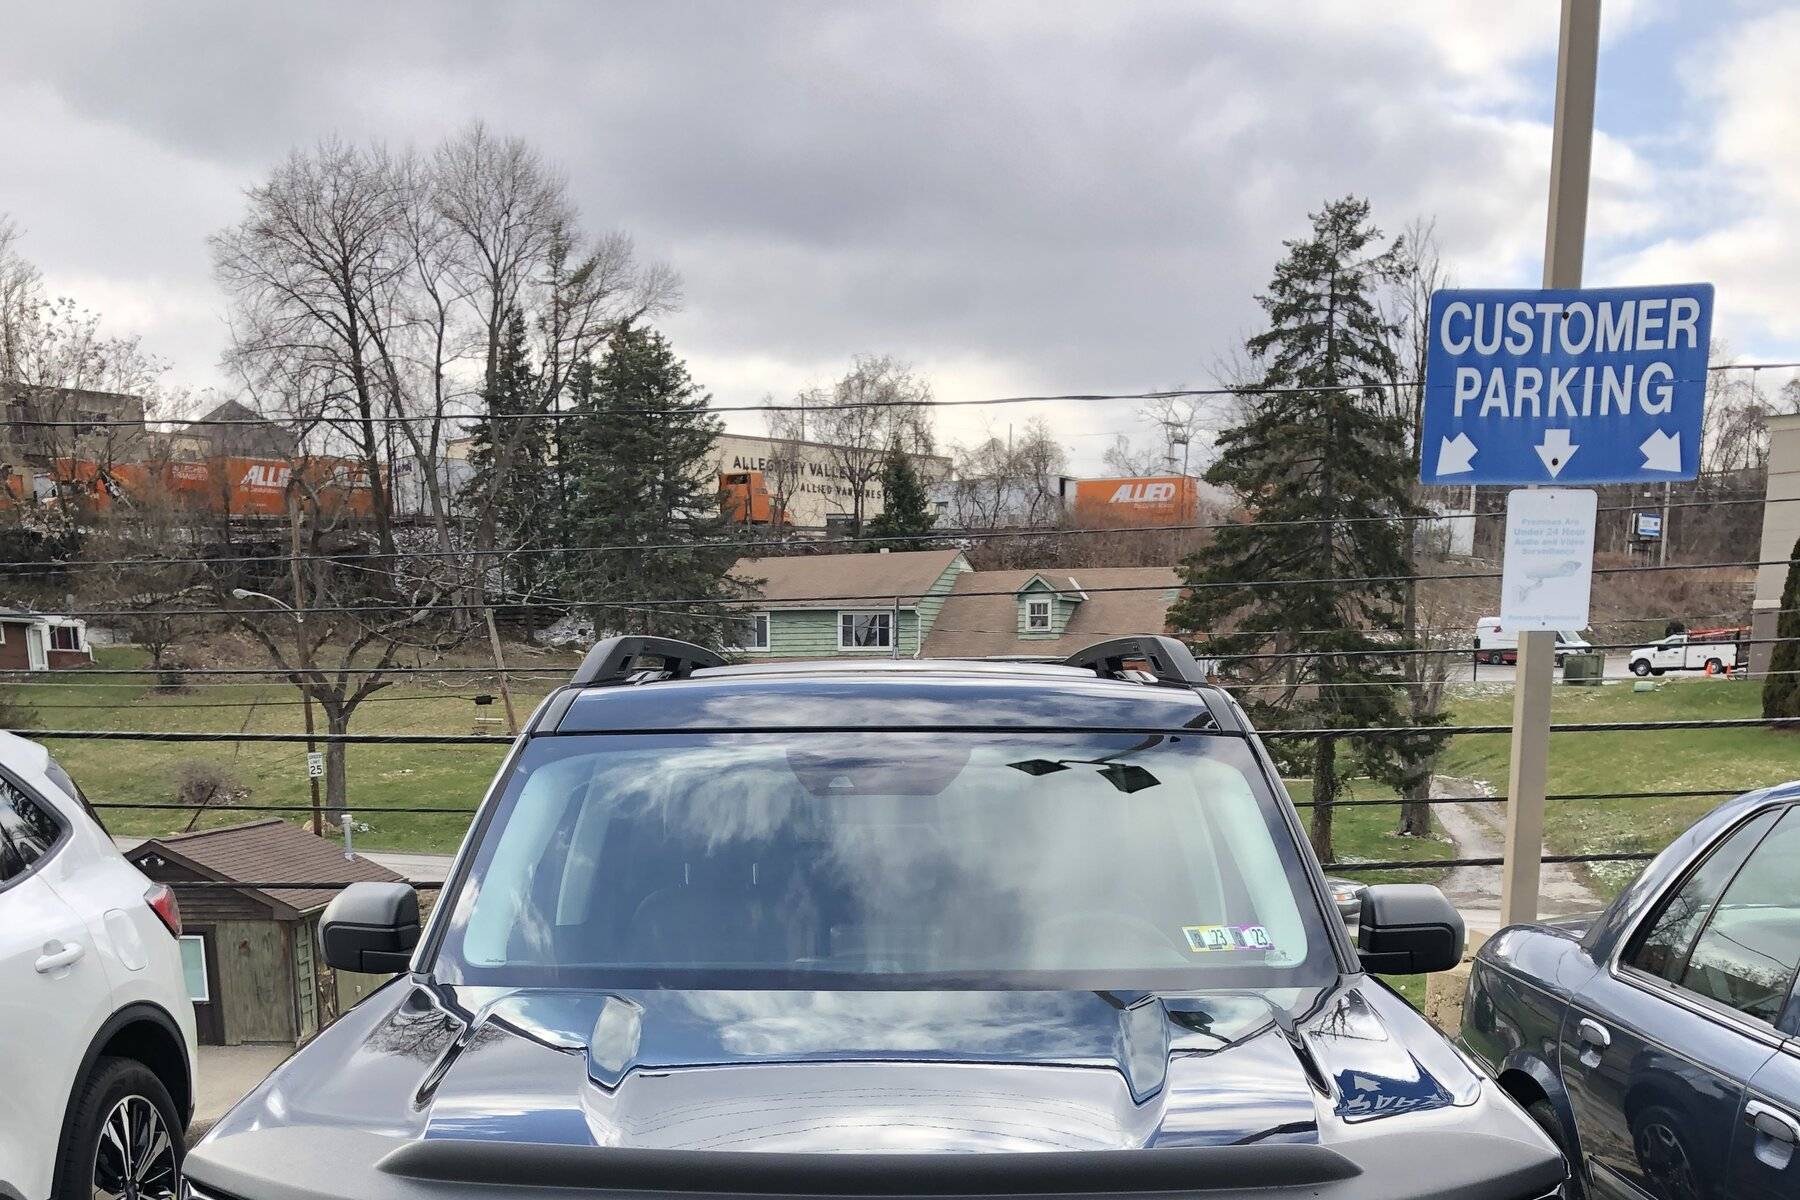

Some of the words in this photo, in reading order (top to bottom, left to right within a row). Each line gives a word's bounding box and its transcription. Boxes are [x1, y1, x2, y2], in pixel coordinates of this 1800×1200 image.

[1440, 298, 1701, 355] CUSTOMER
[1453, 361, 1675, 418] PARKING
[809, 462, 855, 479] VALLE
[1108, 483, 1176, 503] ALLIED
[1513, 527, 1544, 536] Under
[1562, 527, 1586, 536] Hour
[310, 765, 323, 775] 25
